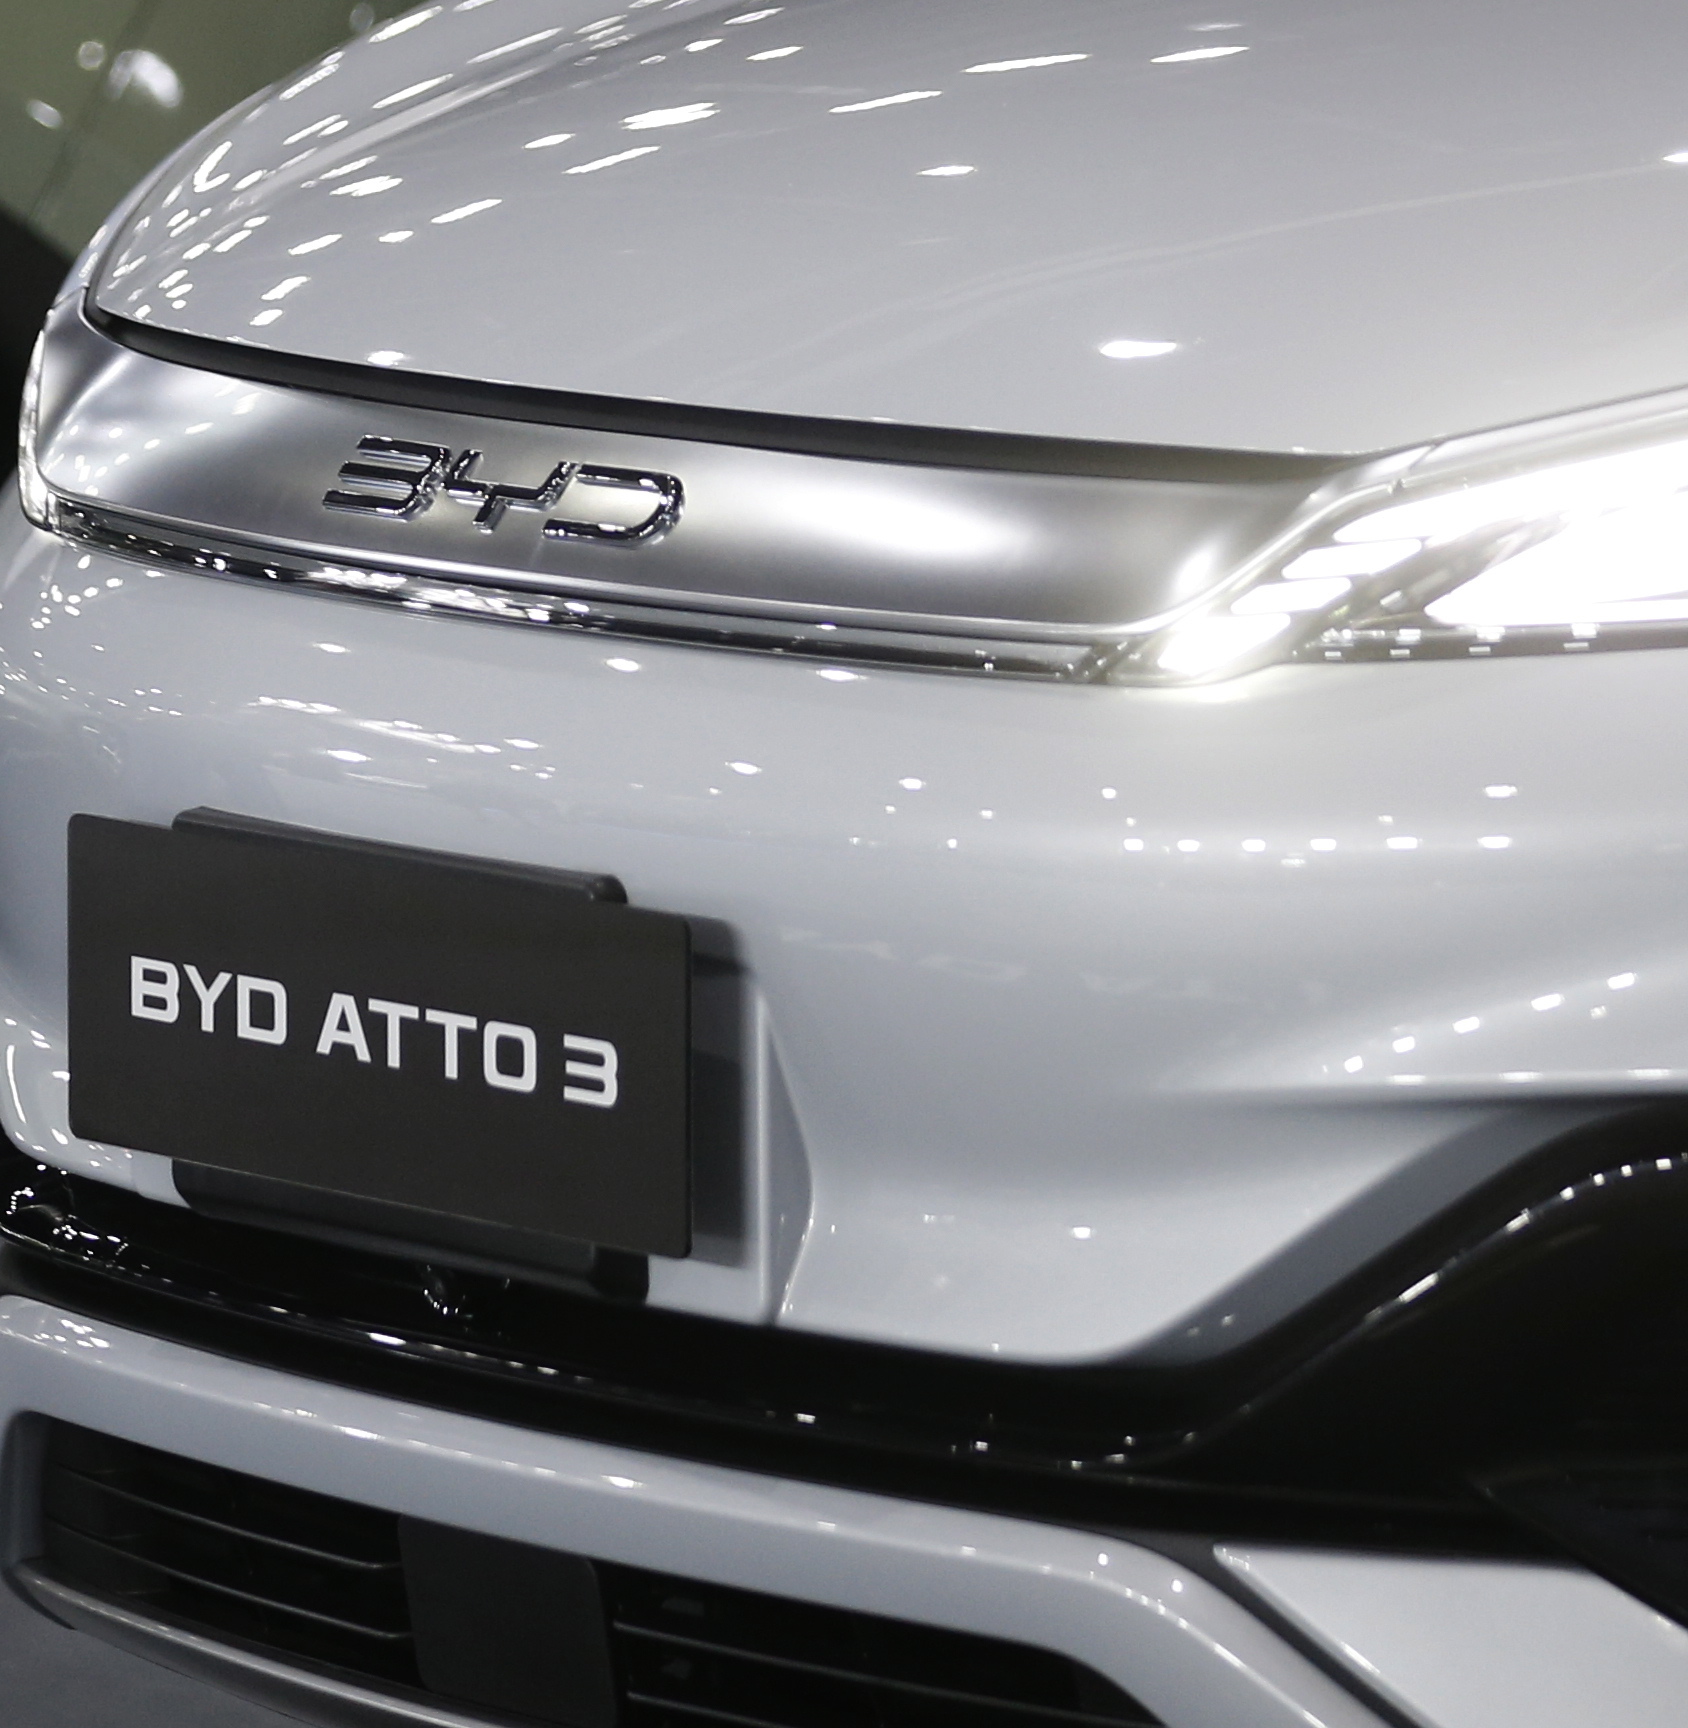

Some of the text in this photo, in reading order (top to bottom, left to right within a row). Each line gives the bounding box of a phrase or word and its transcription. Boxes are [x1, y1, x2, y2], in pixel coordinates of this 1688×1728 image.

[321, 433, 686, 549] BYD
[129, 954, 619, 1109] BYD ATTO 3
